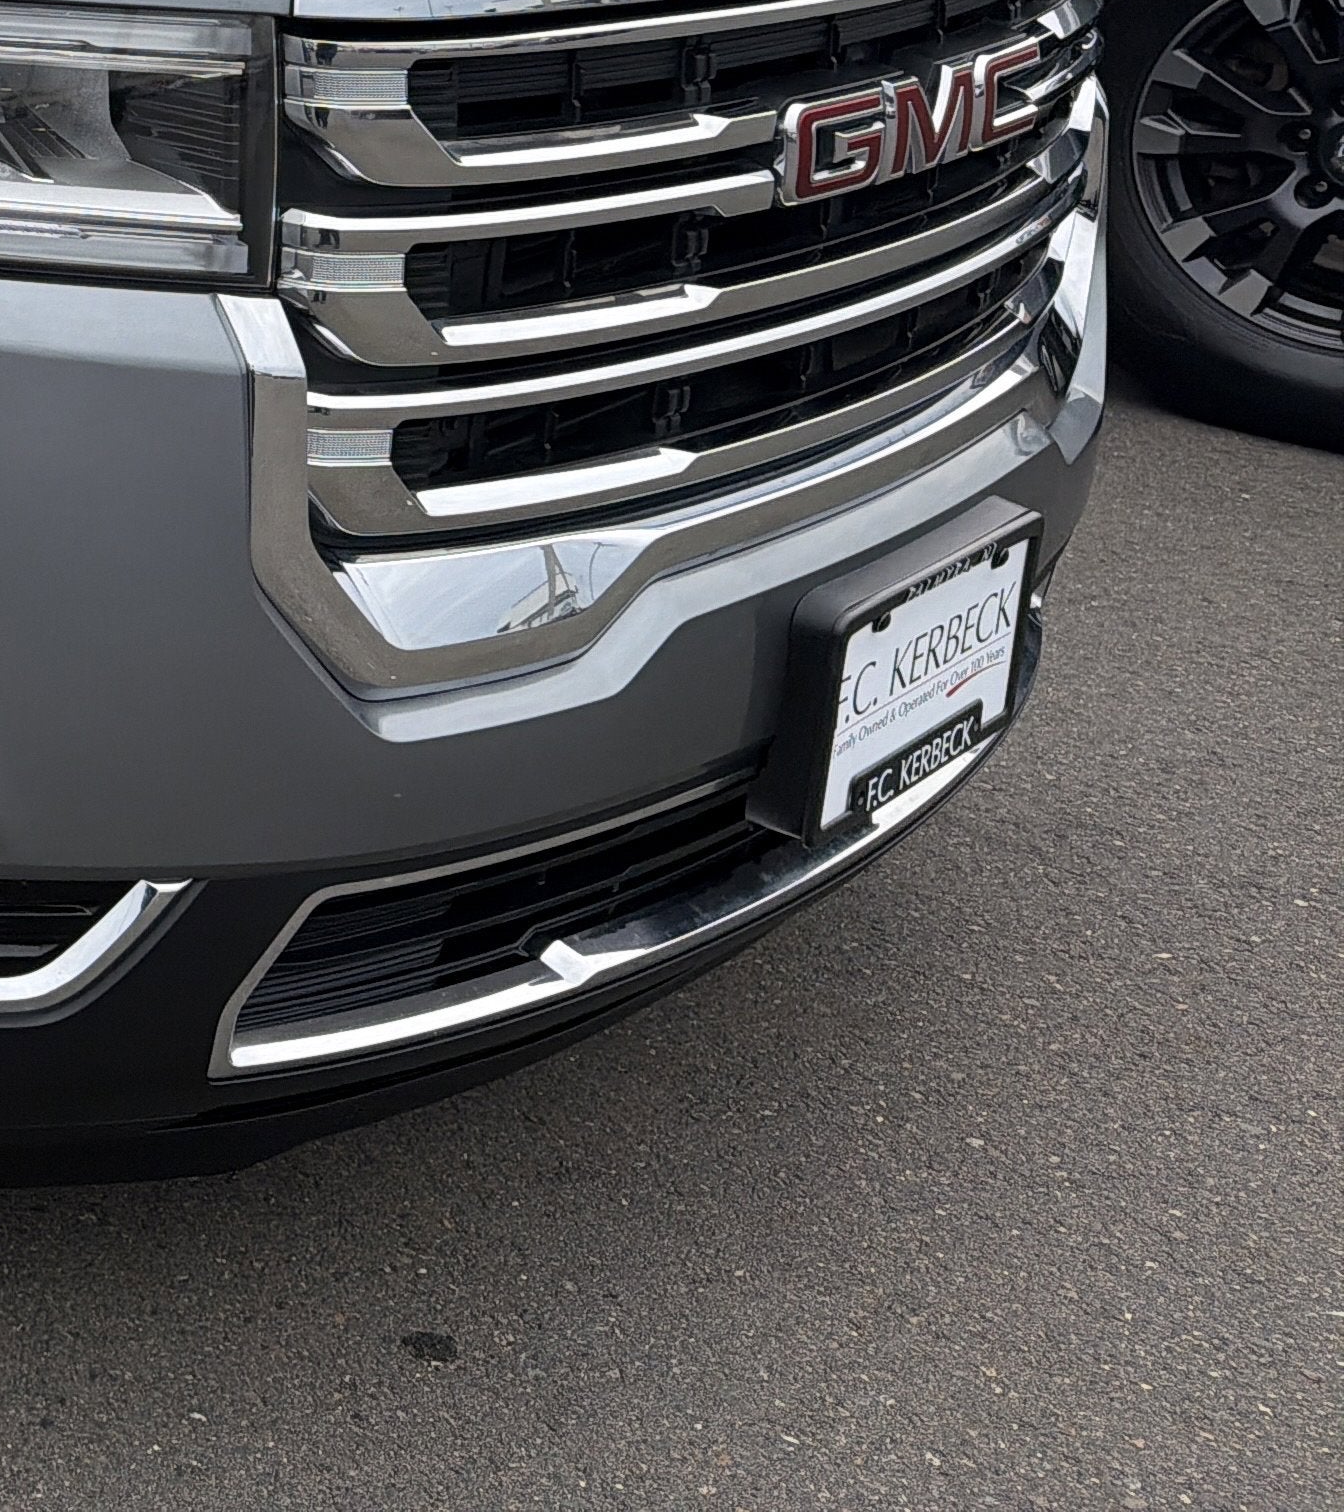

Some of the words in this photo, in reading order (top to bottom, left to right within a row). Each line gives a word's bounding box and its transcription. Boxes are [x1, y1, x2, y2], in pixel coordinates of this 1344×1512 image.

[776, 35, 1042, 208] GMC
[888, 580, 1018, 697] KERBECK
[860, 711, 889, 742] Owned
[898, 681, 936, 718] Operated
[936, 675, 949, 695] For
[950, 665, 970, 687] Over
[971, 656, 985, 674] 100
[986, 645, 1006, 665] Years
[866, 768, 895, 812] F.C.
[899, 715, 975, 791] KERBECK
